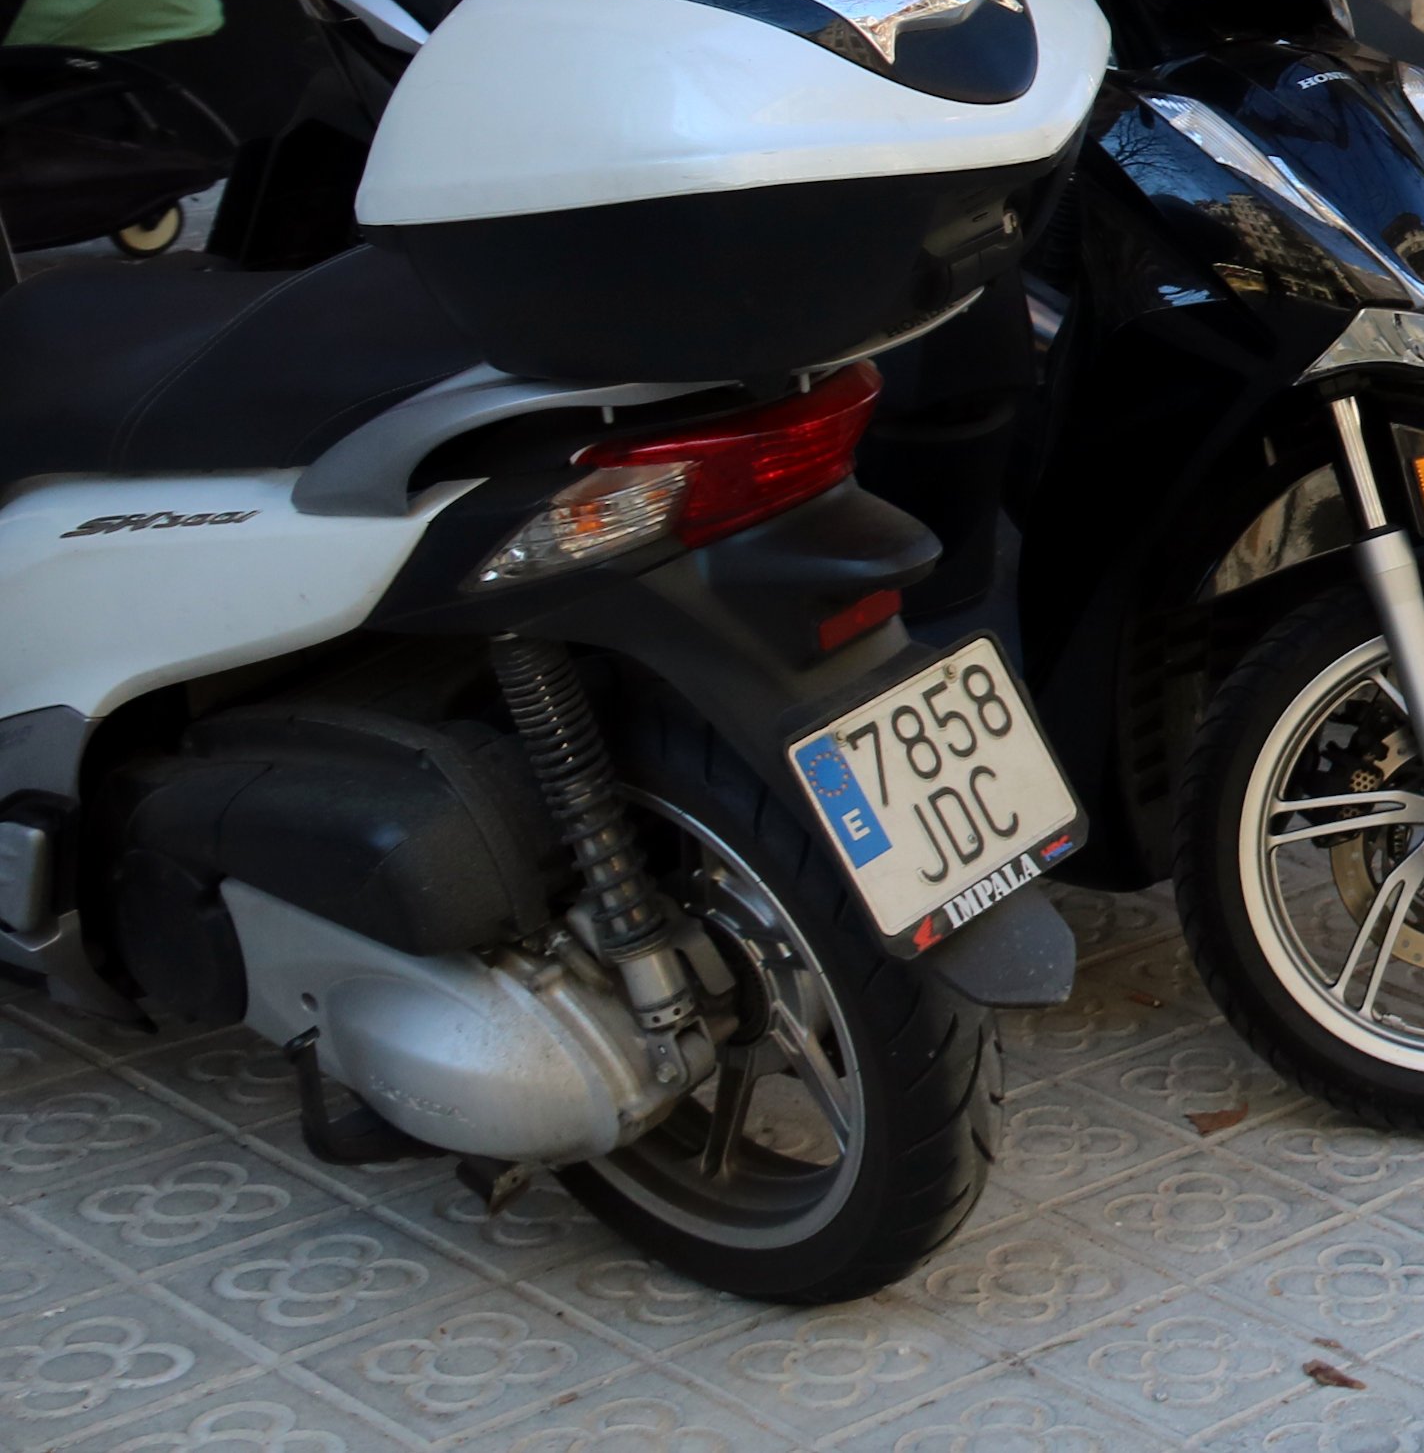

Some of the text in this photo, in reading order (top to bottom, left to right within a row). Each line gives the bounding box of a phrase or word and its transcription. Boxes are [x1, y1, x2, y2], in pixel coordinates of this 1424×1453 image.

[846, 663, 1013, 808] 7858
[842, 807, 871, 842] E
[918, 765, 1020, 884] JDC
[942, 852, 1042, 930] IMPALA
